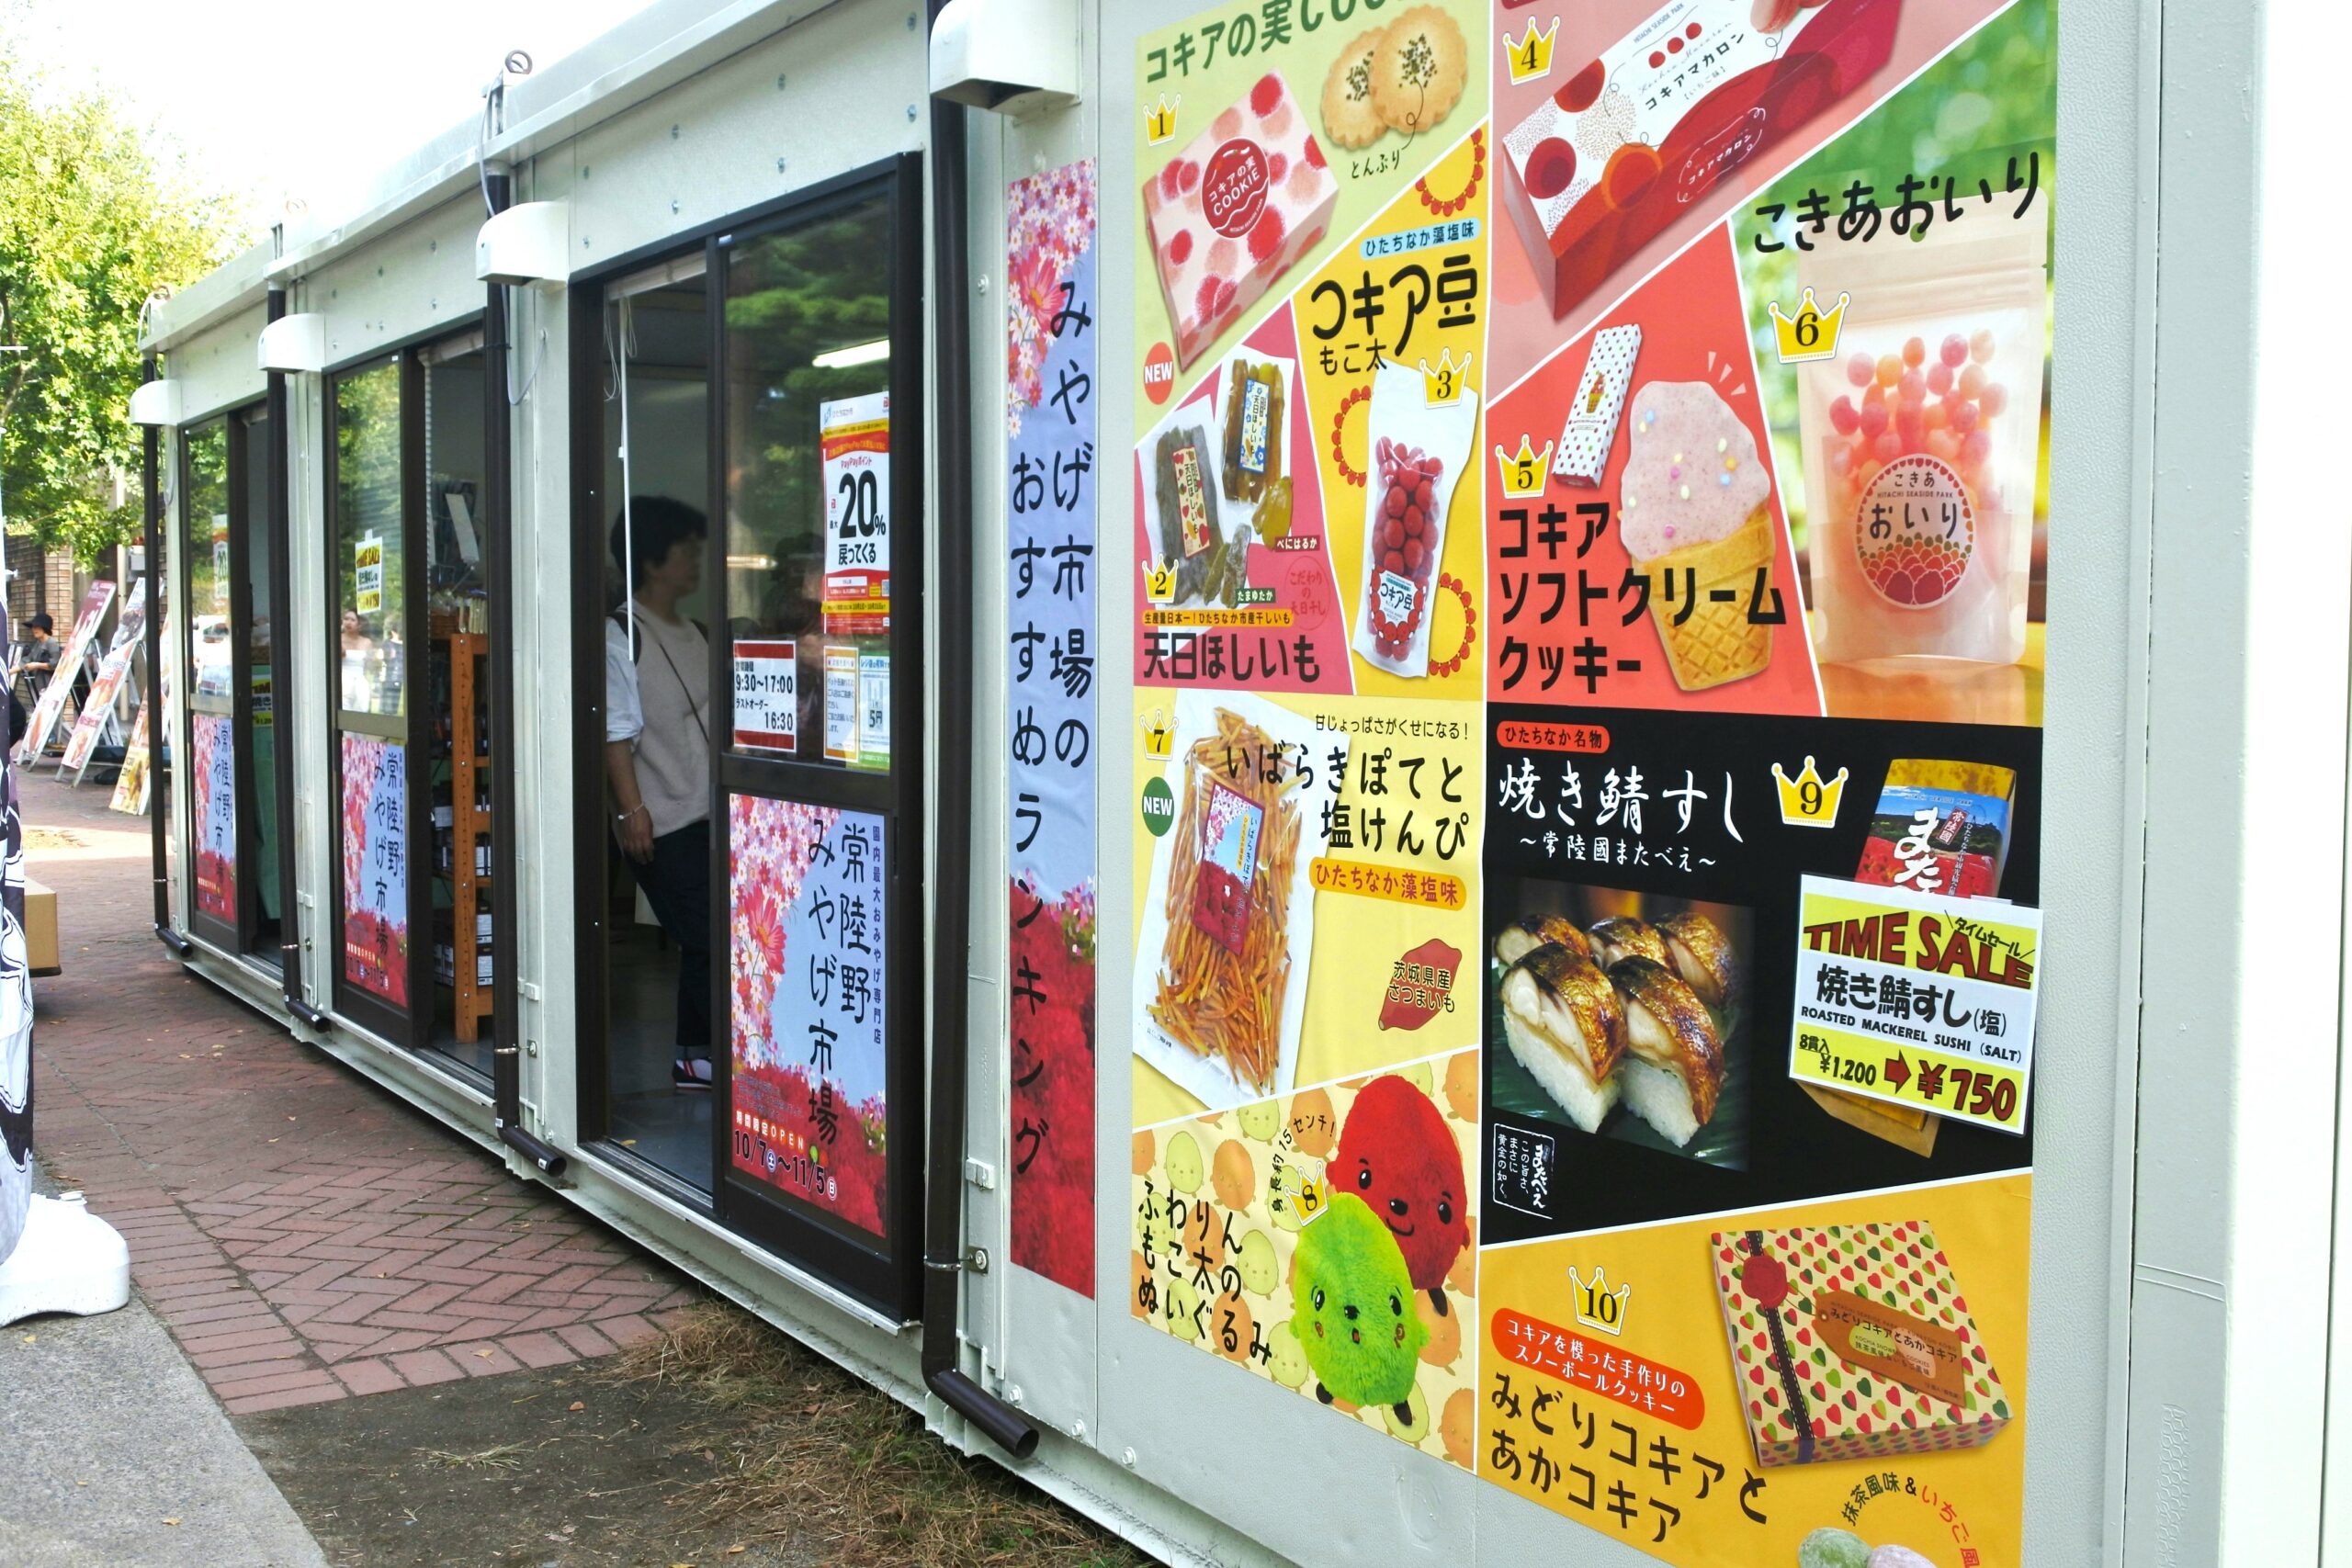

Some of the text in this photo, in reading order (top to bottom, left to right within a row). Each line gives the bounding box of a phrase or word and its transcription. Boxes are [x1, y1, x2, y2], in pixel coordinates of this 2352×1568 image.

[1521, 39, 1538, 71] 4
[1645, 33, 1745, 110] コキアマカロン
[1157, 112, 1166, 137] 1
[1209, 154, 1257, 202] コキアの実
[1351, 149, 1402, 180] とんぶり
[1213, 166, 1261, 216] COOKIE
[1753, 151, 2041, 254] こきあおいり
[1365, 220, 1475, 256] ひたちなか藻塩味
[1310, 254, 1478, 357] コキア豆
[1795, 311, 1819, 347] 6
[1143, 362, 1174, 384] NEW
[1319, 338, 1388, 377] もこ太
[1437, 378, 1453, 399] 3
[1519, 461, 1533, 489] 5
[1894, 471, 1935, 488] こきあ
[838, 469, 887, 539] 20%
[1877, 491, 1905, 499] HITACHI
[1936, 491, 1953, 499] PARK
[1049, 280, 1095, 769] みやげ市場の
[1498, 502, 1611, 559] コキア
[1869, 502, 1957, 540] おいり
[838, 542, 876, 566] 戻ってくる
[1276, 536, 1317, 550] べにはるか
[1155, 570, 1168, 594] 2
[1380, 582, 1413, 611] コキア豆
[1500, 567, 1788, 627] ソフトクリーム
[1143, 632, 1321, 684] 天日ほしいも
[1498, 636, 1643, 695] クッキー
[736, 697, 769, 710] ラストオーダー
[764, 711, 794, 732] 16:30
[1153, 729, 1166, 753] 7
[1315, 713, 1469, 740] 甘じょっぱさがくせになる！
[1504, 726, 1603, 750] ひたちなか名物
[1226, 739, 1464, 804] いばらきぽてと
[1010, 450, 1048, 1177] おすすめランキング
[1143, 795, 1174, 818] NEW
[1498, 756, 1744, 844] 焼き鯖すし
[1800, 780, 1823, 816] 9
[1320, 798, 1470, 862] 塩けんぴ
[1316, 863, 1458, 907] ひたちなか藻塩味
[840, 822, 873, 1025] 常陸野
[1954, 917, 2021, 957] タイムセール
[1804, 911, 2034, 990] TIME SALE
[808, 818, 839, 1146] みやげ市場
[1393, 960, 1451, 990] 茨城県産
[1388, 983, 1456, 1014] さつまいも
[1799, 1033, 1831, 1055] 8貫入
[1801, 1006, 2022, 1064] ROASTED MACKEREL SUSHI (SALT)
[1917, 1059, 2017, 1122] ¥750
[1509, 1137, 1519, 1174] まさに
[1138, 1179, 1243, 1256] ふわりん
[1302, 1184, 1318, 1213] 8
[1141, 1224, 1242, 1303] もこ太の
[1138, 1275, 1272, 1367] ぬいぐるみ
[1584, 1287, 1619, 1325] 10
[1829, 1307, 1958, 1363] みどりコキアとあかコキア
[1507, 1318, 1686, 1398] コキアを模った手作りの
[1491, 1371, 1768, 1525] みどりコキアと
[1491, 1428, 1681, 1543] あかコキア
